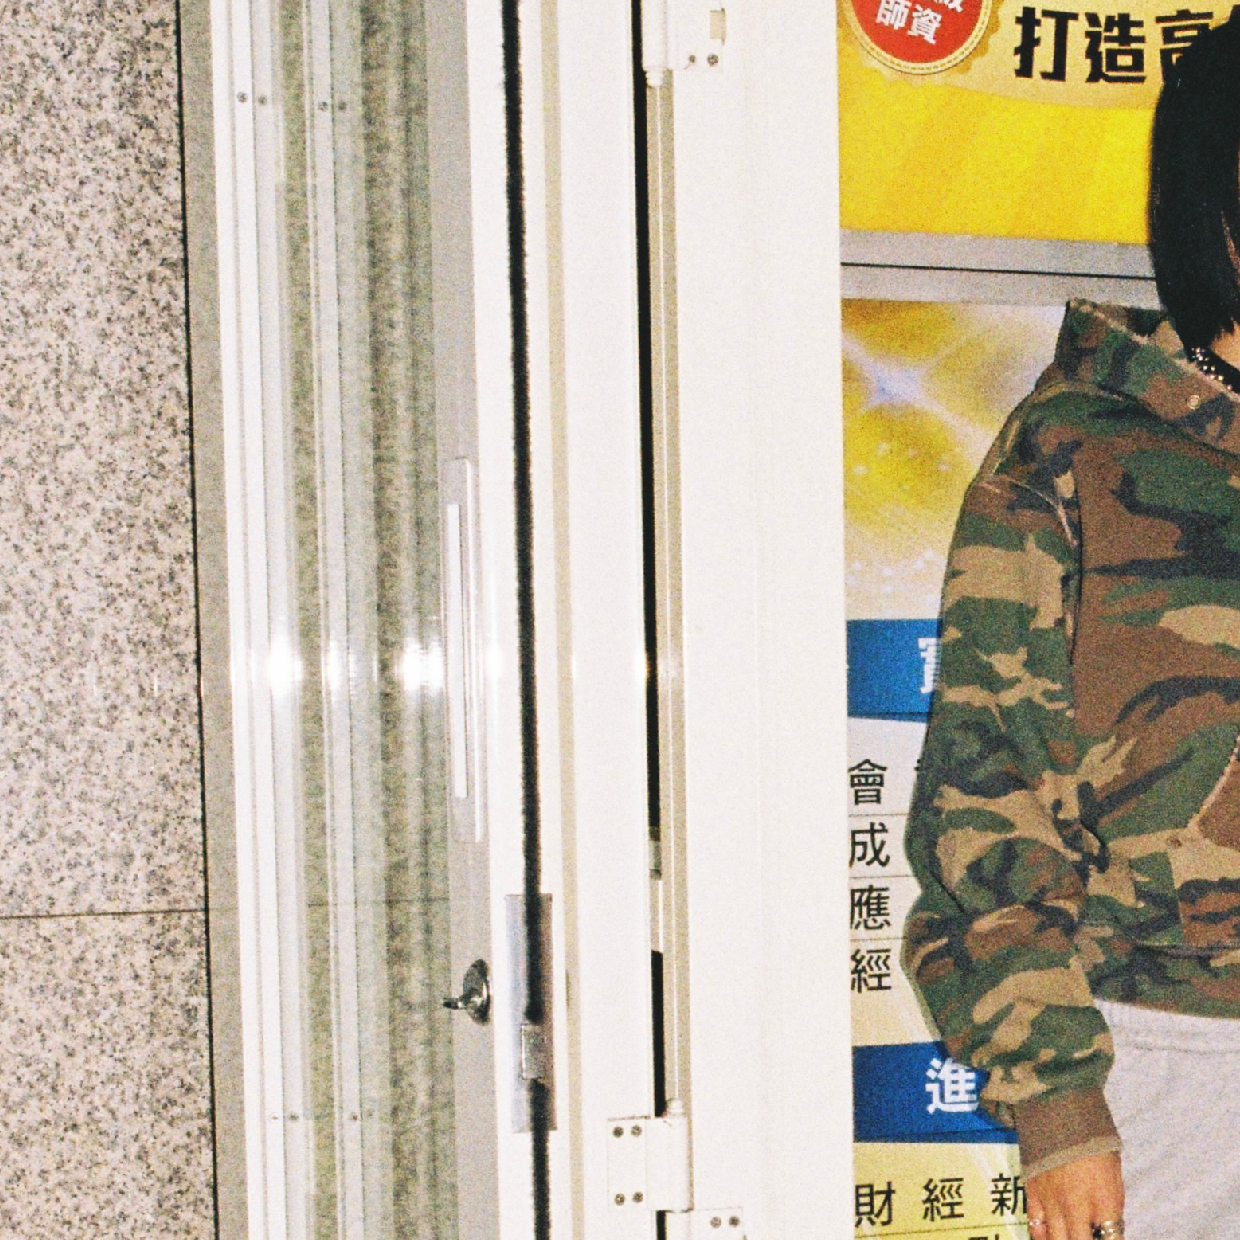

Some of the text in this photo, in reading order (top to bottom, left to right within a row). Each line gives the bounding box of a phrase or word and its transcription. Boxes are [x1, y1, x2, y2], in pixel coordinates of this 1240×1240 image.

[848, 759, 888, 806] 會
[849, 822, 890, 867] 成
[850, 884, 891, 931] 應
[850, 948, 892, 993] 經
[925, 1057, 979, 1114] 進
